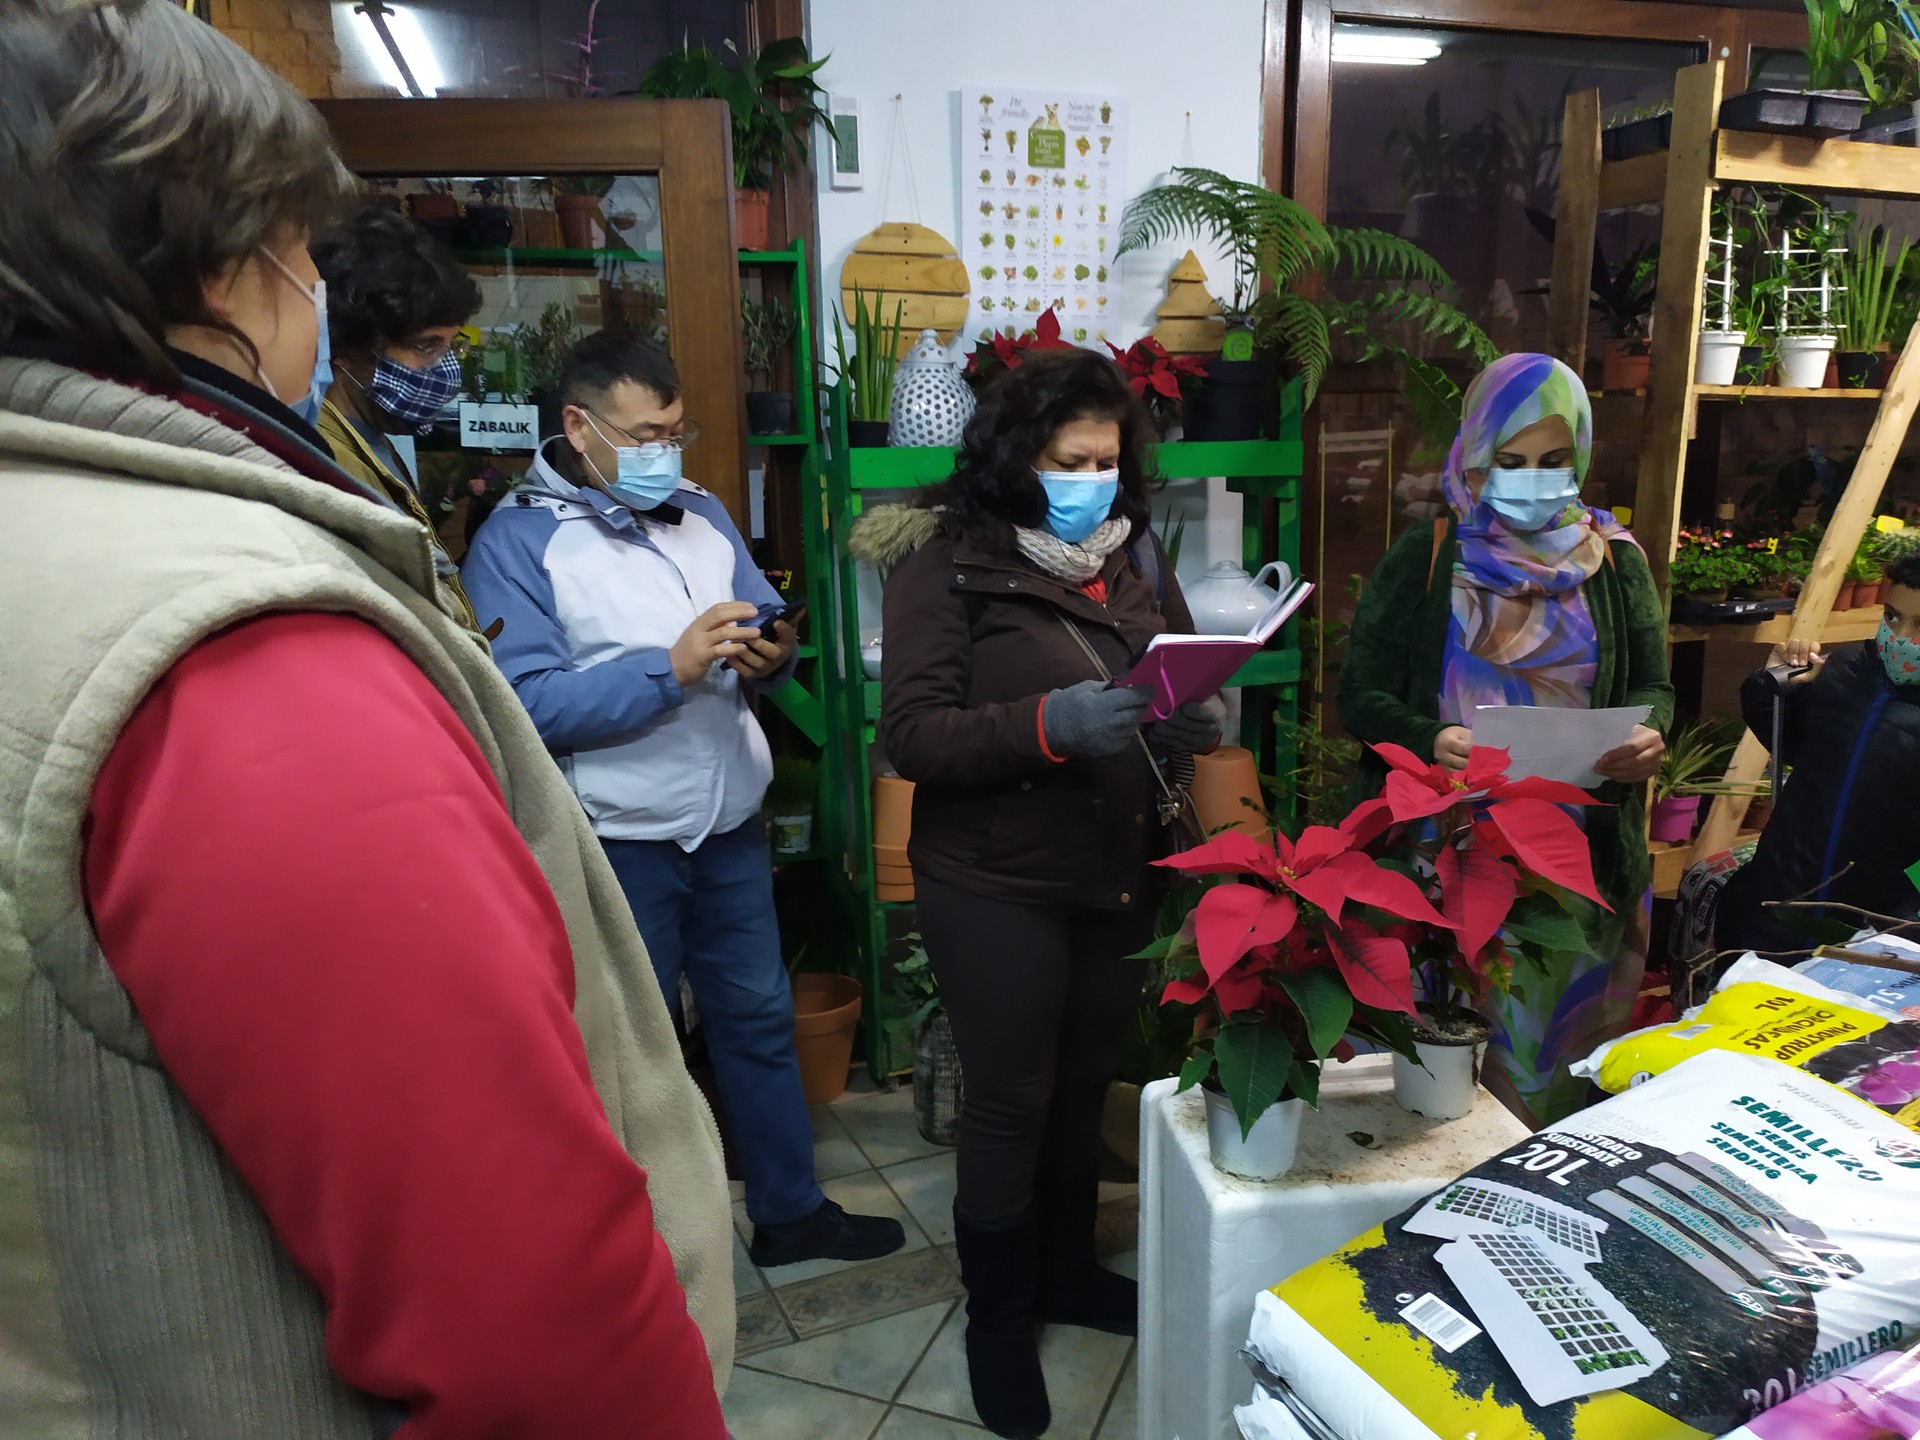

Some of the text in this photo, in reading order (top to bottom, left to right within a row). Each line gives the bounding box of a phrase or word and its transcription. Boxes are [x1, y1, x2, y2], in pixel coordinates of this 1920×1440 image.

[469, 421, 530, 434] ZABALIK
[1774, 1022, 1858, 1061] PINDSTRUP
[1542, 1132, 1626, 1168] SUBSTRATE
[1710, 1122, 1818, 1185] SEMENTEIRA
[1731, 1095, 1883, 1181] SEMILLERO
[1755, 1129, 1811, 1160] SEMIS
[1501, 1143, 1590, 1187] 20 L
[1688, 1189, 1715, 1208] AVEC
[1697, 1184, 1731, 1209] SPECIAL
[1627, 1216, 1690, 1258] WITH PERLITE
[1628, 1207, 1706, 1260] SPECIAL SEEDING
[1651, 1189, 1744, 1251] ESPECIAL SEMENTEIRA
[1659, 1203, 1718, 1242] COM PERLITA
[1802, 1319, 1903, 1384] SEMILLERO
